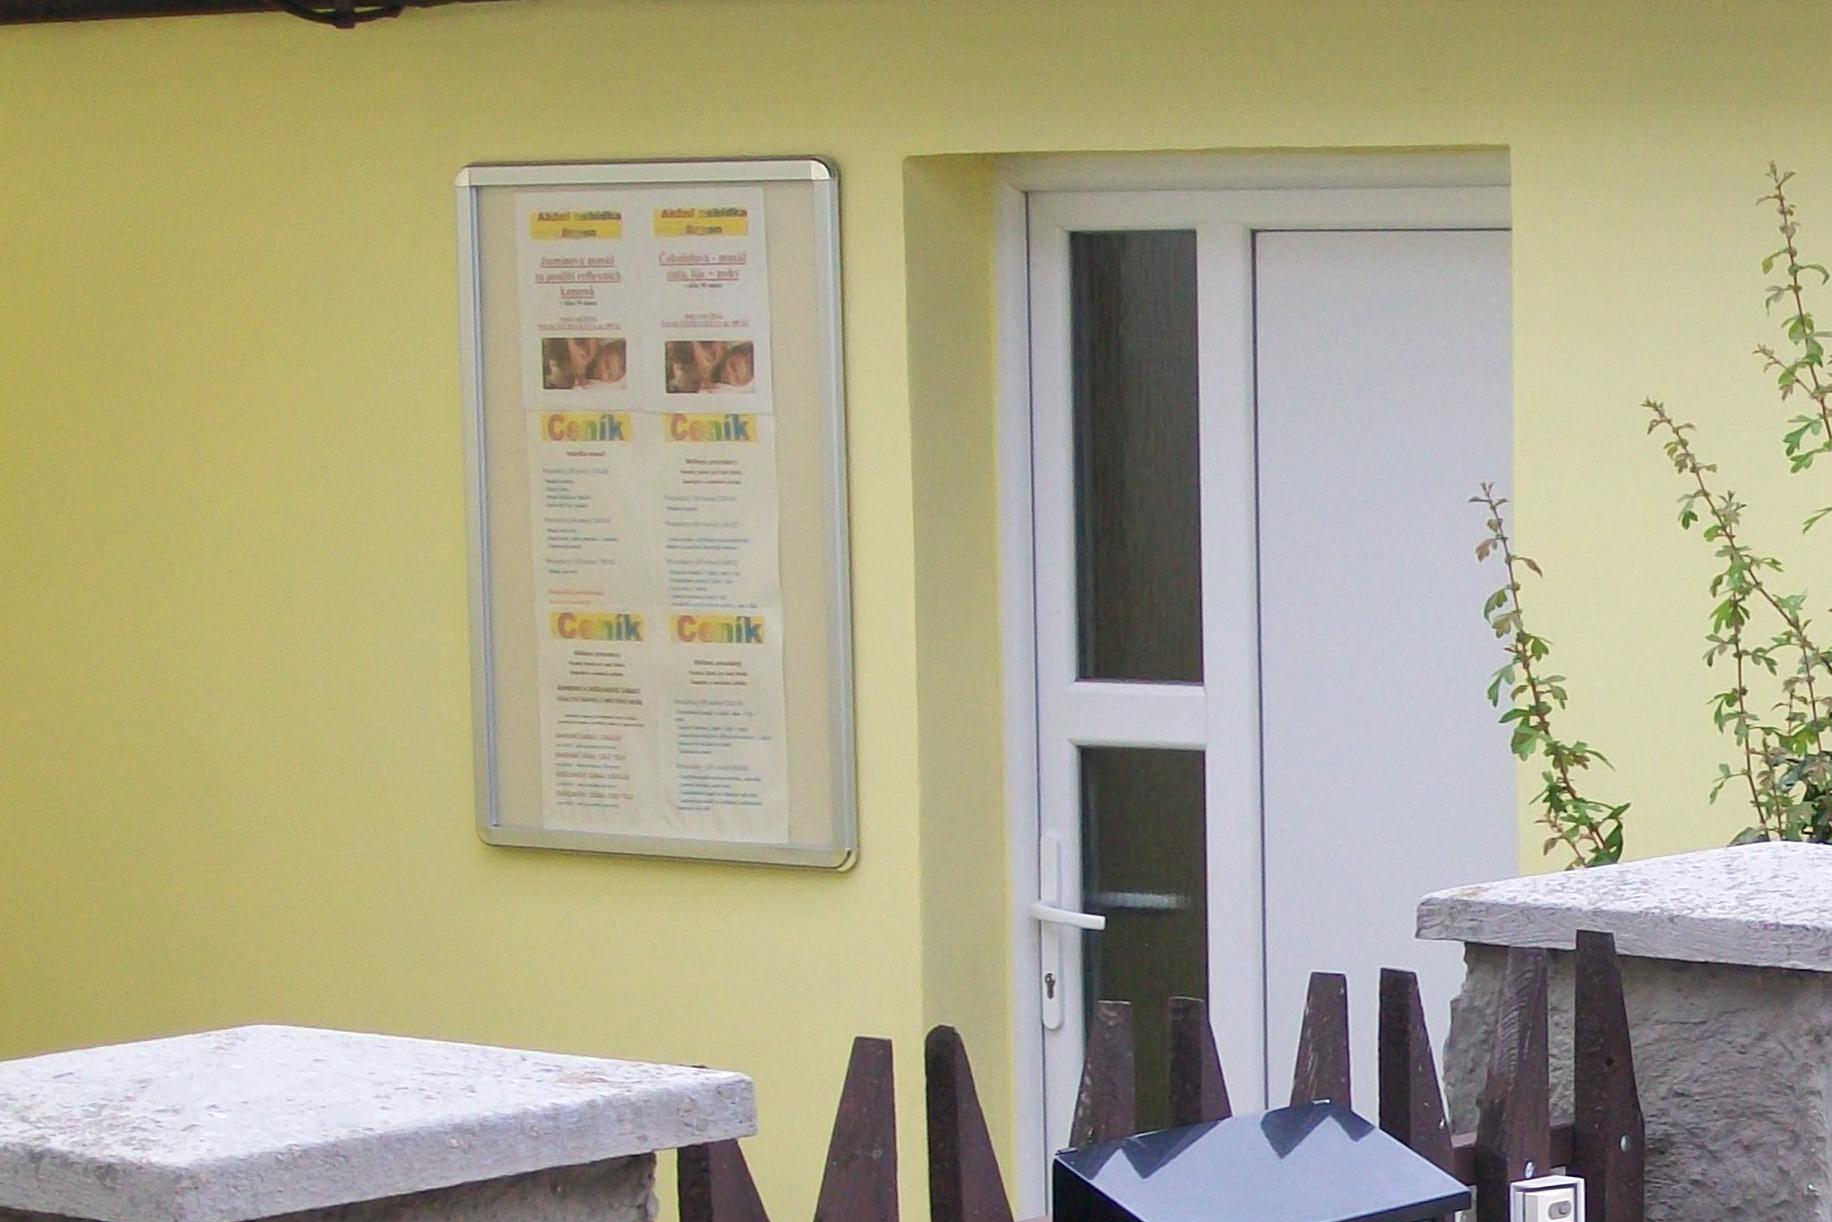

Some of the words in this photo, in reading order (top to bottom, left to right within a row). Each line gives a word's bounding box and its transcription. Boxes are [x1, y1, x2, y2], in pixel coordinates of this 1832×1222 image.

[547, 413, 625, 441] Ceník
[670, 413, 750, 441] Ceník
[557, 612, 643, 641] Ceník
[677, 615, 764, 644] Ceník
